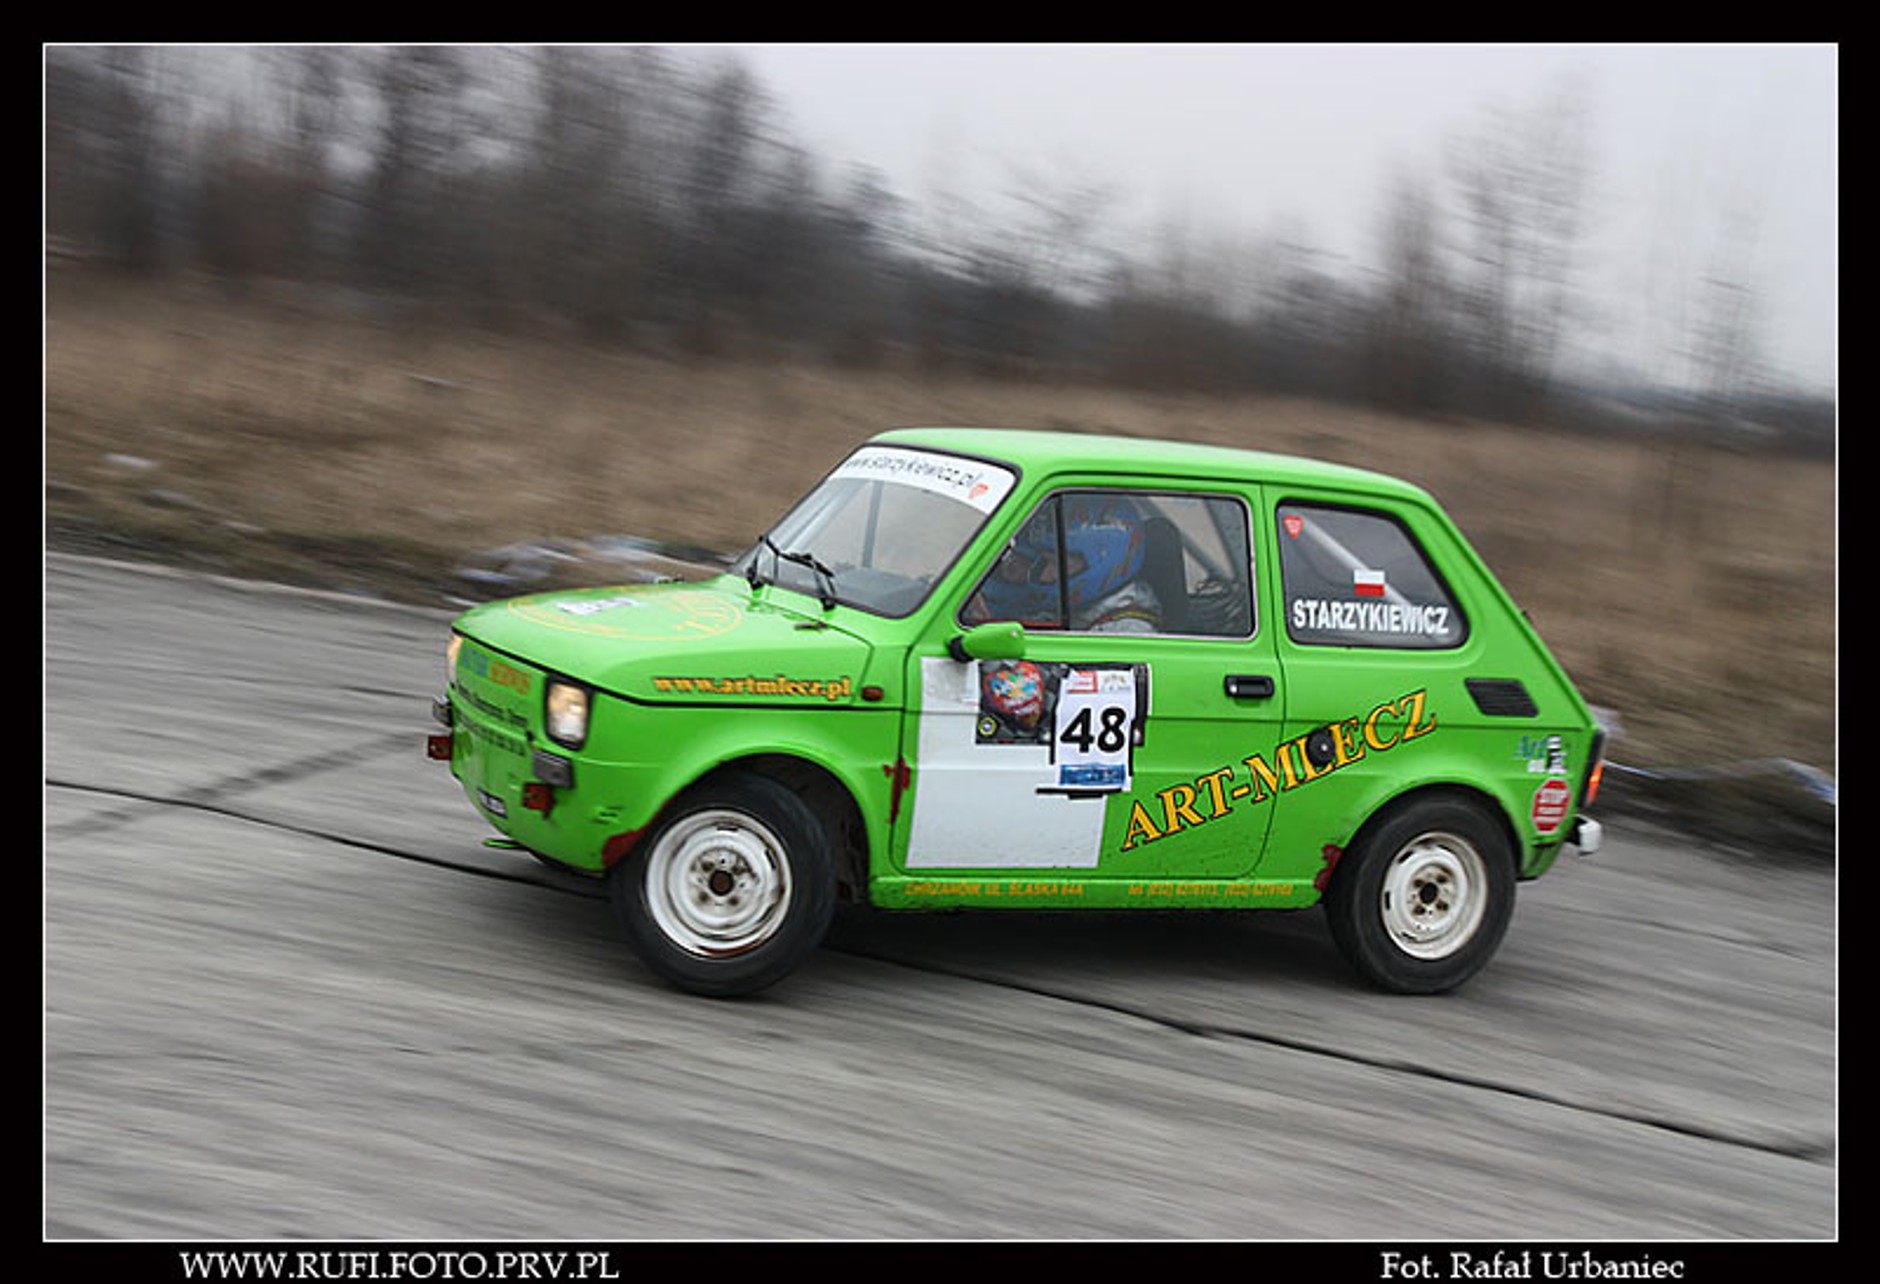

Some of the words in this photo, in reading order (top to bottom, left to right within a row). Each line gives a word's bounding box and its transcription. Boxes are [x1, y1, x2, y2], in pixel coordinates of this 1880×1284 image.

[1292, 599, 1449, 634] STARZYKIEWICZ
[653, 674, 850, 701] www.artmlecz.pl
[1060, 706, 1127, 753] 48
